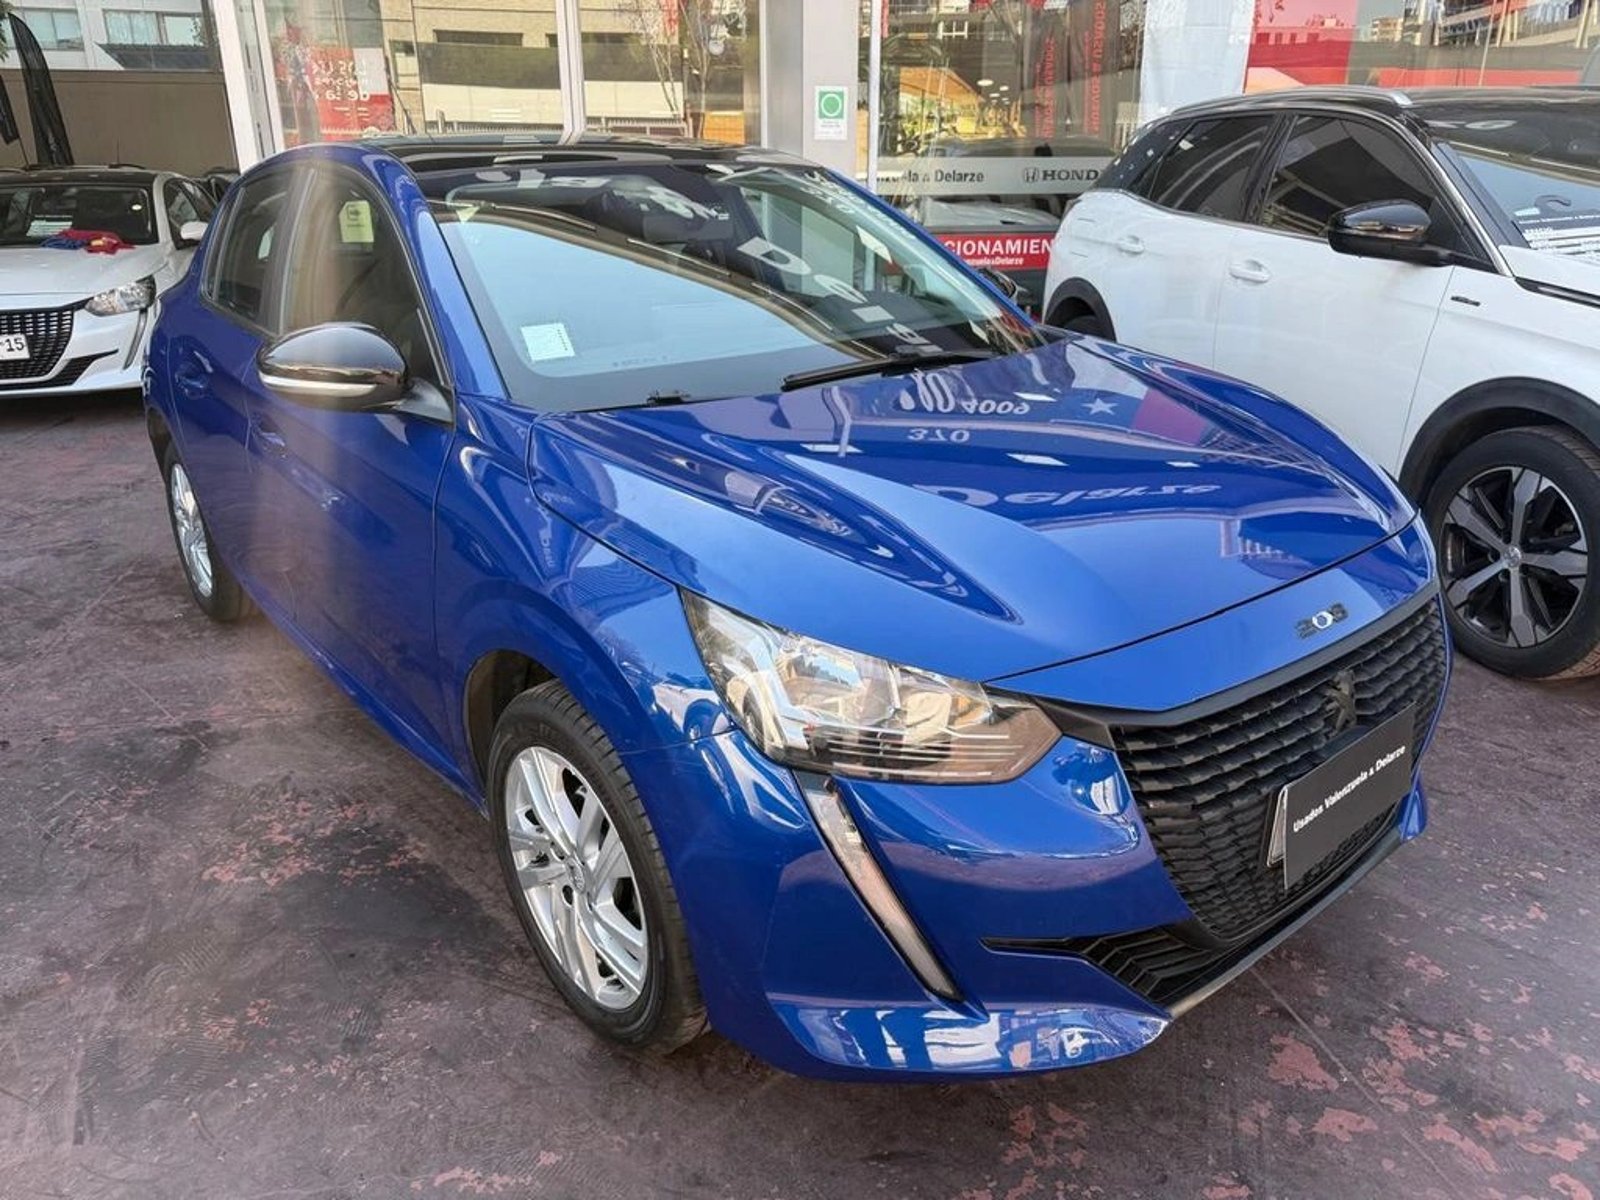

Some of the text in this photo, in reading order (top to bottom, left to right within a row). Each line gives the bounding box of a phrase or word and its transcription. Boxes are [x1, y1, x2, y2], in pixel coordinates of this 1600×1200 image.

[935, 169, 984, 182] Delarze
[1042, 170, 1099, 181] HOND
[1293, 805, 1324, 832] Usados
[1324, 771, 1368, 809] Valenzuela
[1376, 745, 1406, 771] Delarze
